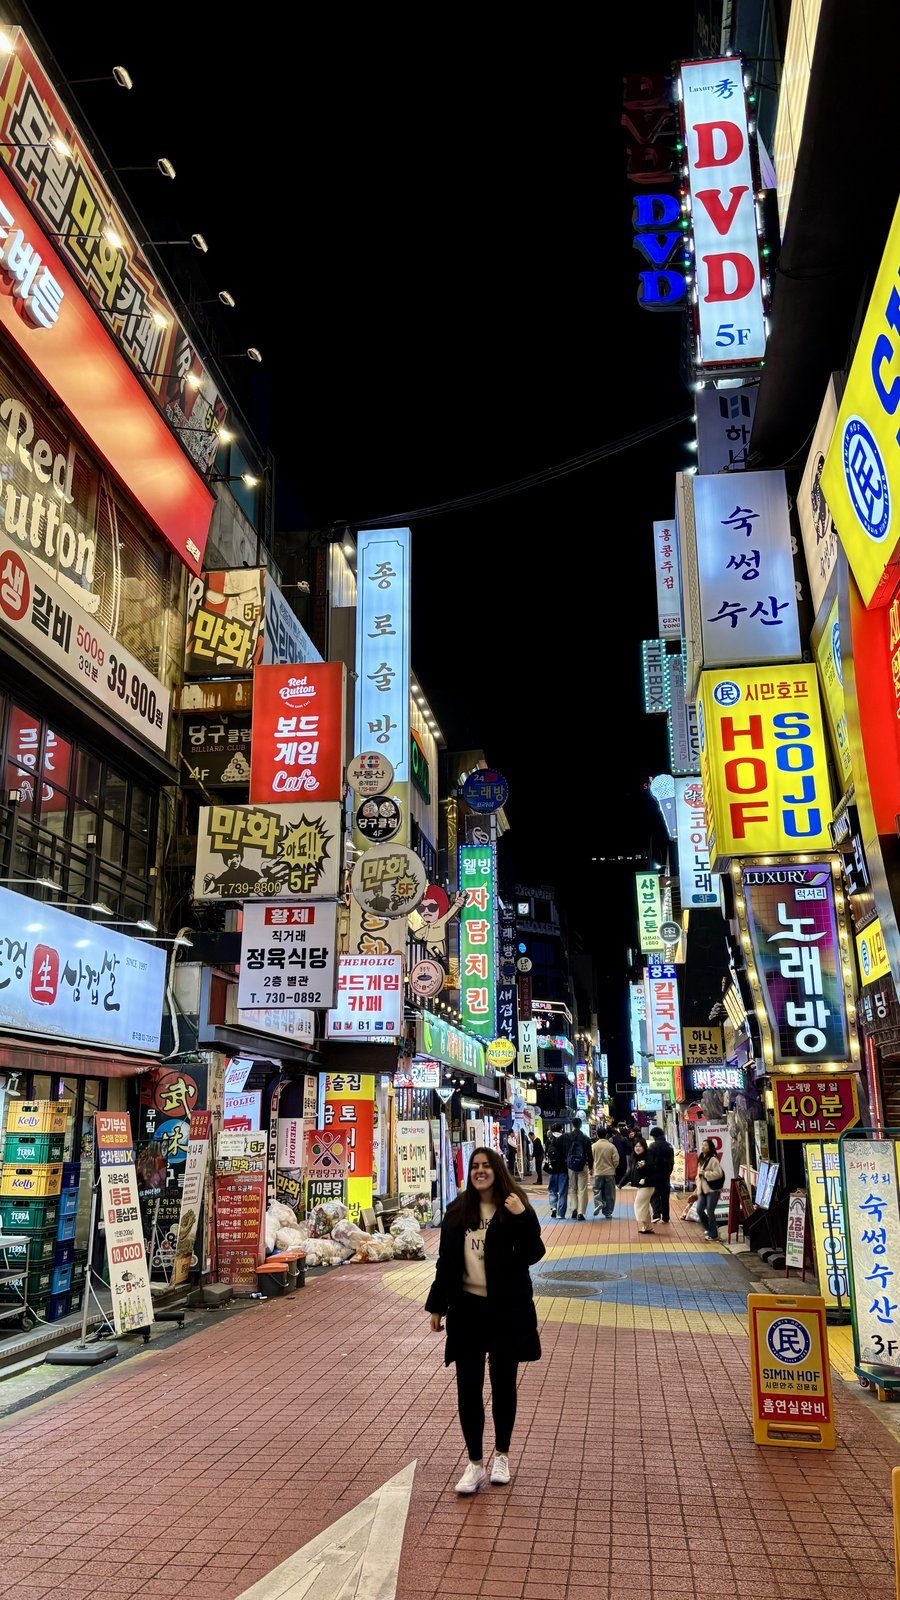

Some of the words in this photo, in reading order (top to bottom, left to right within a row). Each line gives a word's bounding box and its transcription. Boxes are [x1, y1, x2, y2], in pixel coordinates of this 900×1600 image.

[689, 84, 715, 94] Luxury
[714, 79, 738, 99] 秀
[692, 120, 755, 303] DVD
[633, 193, 687, 303] DVD
[715, 324, 751, 347] 5F
[0, 398, 75, 504] Red
[0, 484, 95, 585] utton
[659, 528, 674, 590] 홍콩주점
[0, 558, 26, 612] 생
[31, 584, 73, 656] 갈비
[243, 602, 261, 621] 5F
[707, 596, 790, 629] 수산
[76, 624, 105, 668] 500g
[193, 608, 253, 668] 만화
[366, 561, 397, 745] 종로술방
[647, 643, 662, 673] THE
[78, 655, 99, 683] 3인분
[287, 675, 307, 687] Red
[648, 675, 664, 706] BOX
[106, 654, 164, 730] 39,900원
[279, 685, 317, 699] Button
[720, 686, 735, 701] 民
[744, 681, 808, 702] 시민호프
[188, 726, 226, 745] 당구
[274, 715, 319, 737] 보드
[191, 745, 225, 753] BILLIARD
[227, 744, 246, 752] CLUB
[273, 741, 318, 766] 게임
[188, 767, 210, 781] 4F
[271, 770, 320, 793] Cafe
[352, 770, 386, 779] 부동산
[720, 714, 769, 840] HOF
[772, 711, 823, 838] SOJU
[466, 786, 505, 801] 노래방
[209, 807, 283, 858] 만화
[357, 818, 398, 830] 당구클럽
[372, 829, 383, 838] 4F
[362, 856, 409, 885] 만화
[462, 858, 492, 875] 웰빙
[290, 869, 318, 892] 5F
[744, 870, 808, 885] LUXURY
[217, 882, 282, 896] T.739-8800
[397, 882, 414, 895] 5F
[796, 889, 826, 899] 럭셔리
[270, 907, 310, 924] 황제
[640, 878, 659, 934] 샤브스톤
[272, 930, 306, 943] 직거래
[246, 947, 328, 970] 정육식당
[465, 886, 490, 1014] 자담치킨
[61, 949, 121, 1012] 삼겹살
[650, 965, 676, 978] 공주
[766, 902, 831, 1054] 노래방
[263, 976, 282, 988] 2층
[286, 975, 309, 988] 별관
[250, 993, 260, 1004] T.
[265, 992, 321, 1003] 730-0892
[347, 995, 382, 1012] 카페
[653, 981, 678, 1041] 칼국수
[358, 1021, 370, 1031] B1
[692, 1030, 712, 1041] 하나
[523, 1023, 532, 1064] YUME
[655, 1043, 681, 1057] 포차
[688, 1042, 719, 1055] 부동산
[785, 1082, 811, 1092] 노래방
[817, 1082, 838, 1092] 평일
[225, 1096, 256, 1108] HOLIC
[781, 1094, 843, 1118] 40분
[17, 1116, 40, 1127] Kelly
[100, 1116, 127, 1132] 고기부심
[146, 1109, 156, 1134] 무림
[794, 1119, 837, 1132] 서비스
[17, 1147, 36, 1157] TERRA
[250, 1141, 265, 1153] 5F
[289, 1120, 298, 1166] THEHOLIC
[218, 1159, 264, 1171] 무림만화카페
[308, 1169, 345, 1179] 무림당구장
[11, 1179, 35, 1190] Kelly
[275, 1174, 301, 1198] 만화
[858, 1172, 891, 1185] 숙성회
[310, 1181, 343, 1196] 10분당
[10, 1211, 30, 1221] TERRA
[8, 1244, 27, 1254] TERRA
[114, 1244, 143, 1263] 10,000
[777, 1327, 803, 1354] 民
[871, 1334, 900, 1358] 3F
[762, 1368, 795, 1382] SIMIN
[797, 1371, 821, 1383] HOF
[763, 1398, 826, 1418] 흡연실완비
